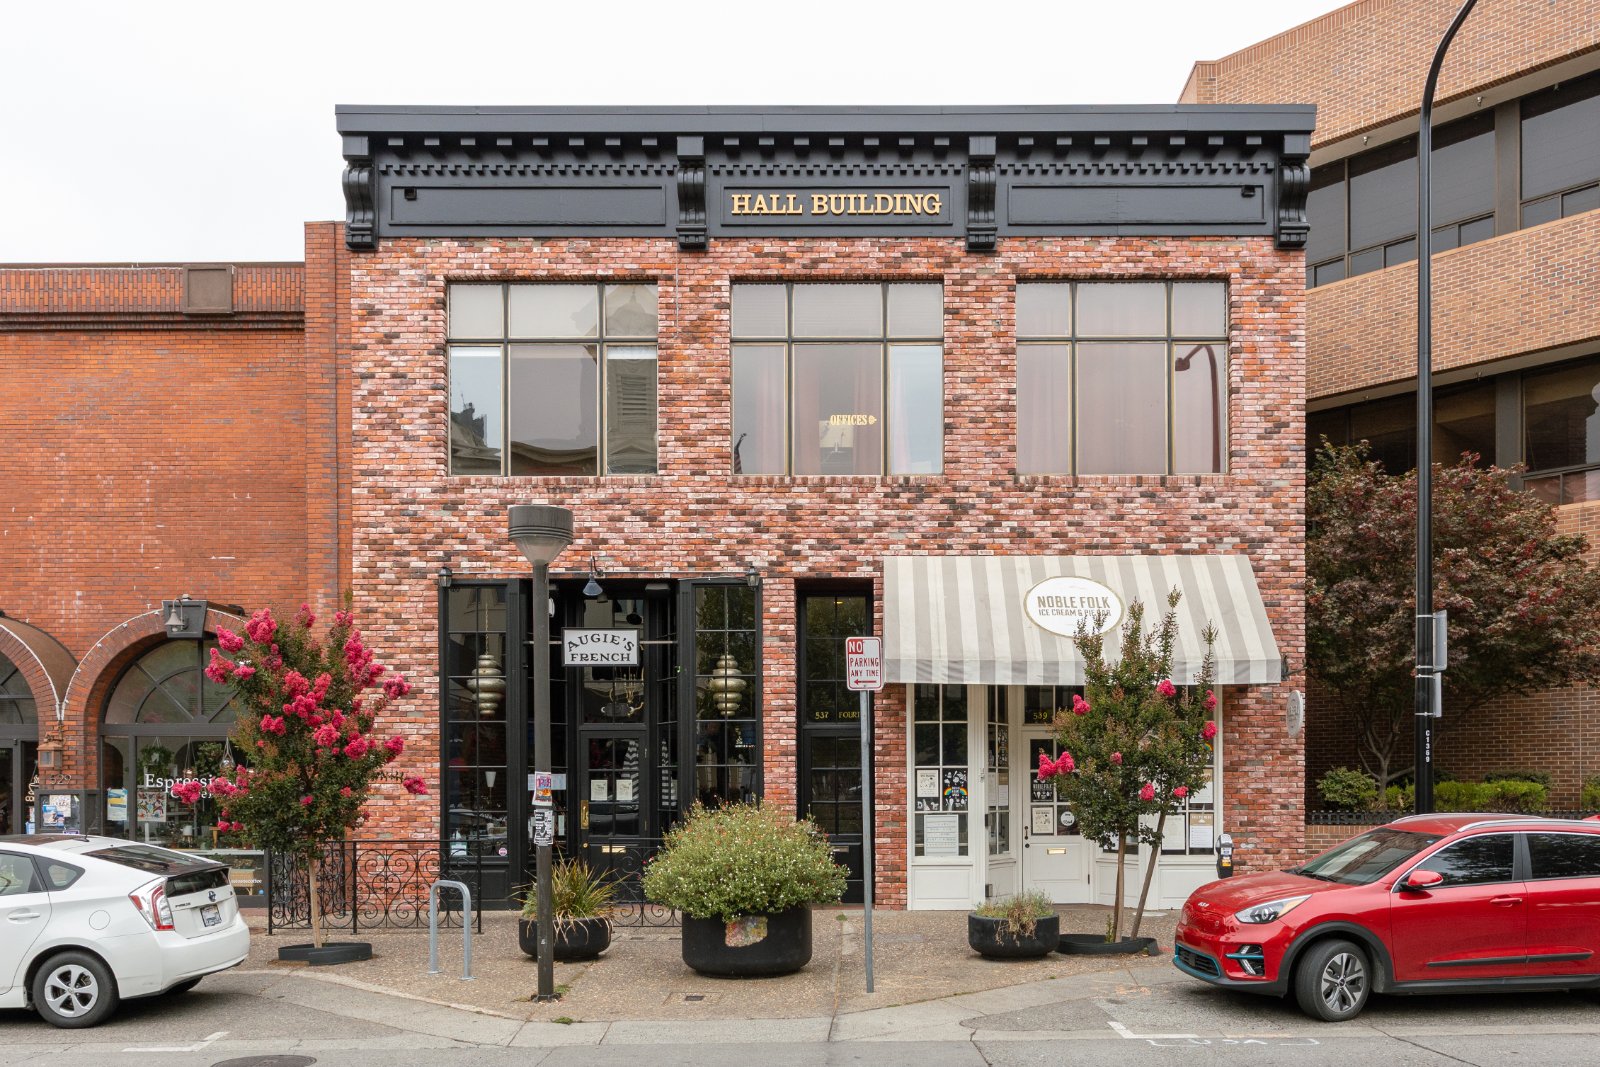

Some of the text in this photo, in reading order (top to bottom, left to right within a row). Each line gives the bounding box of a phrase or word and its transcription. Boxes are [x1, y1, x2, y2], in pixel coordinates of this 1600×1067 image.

[731, 193, 942, 215] HALL BUILDING
[830, 414, 867, 426] OFFICES
[1037, 595, 1111, 609] NOBLE FOLK
[1051, 609, 1077, 617] CREAM
[1084, 609, 1096, 617] PIE
[567, 633, 634, 652] AUGIE'S
[849, 641, 863, 653] NO
[570, 653, 631, 662] FRENCH
[849, 657, 879, 667] PARKING
[815, 711, 861, 720] 537 FOURT
[1033, 711, 1048, 720] 539
[49, 774, 72, 785] 529
